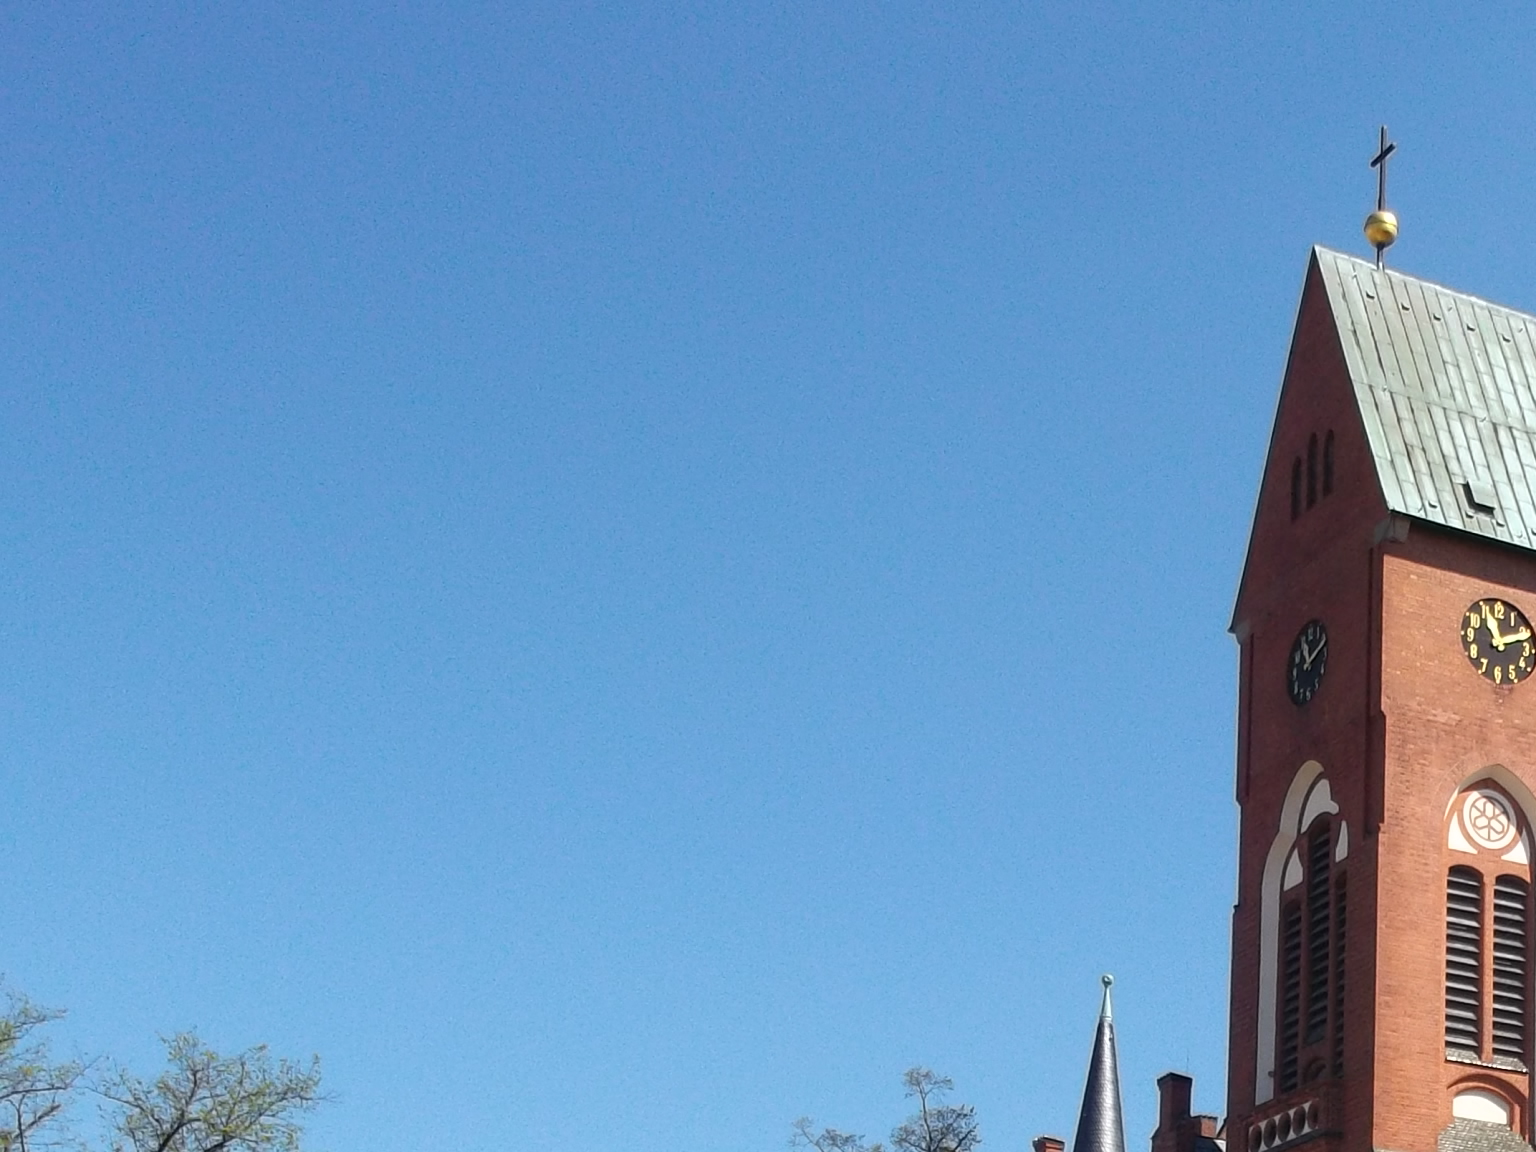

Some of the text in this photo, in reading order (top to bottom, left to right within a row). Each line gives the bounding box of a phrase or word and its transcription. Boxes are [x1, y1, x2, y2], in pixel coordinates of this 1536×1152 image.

[1494, 603, 1504, 619] 12
[1470, 612, 1480, 628] 10
[1510, 612, 1515, 627] 1
[1466, 627, 1474, 642] 9
[1470, 644, 1478, 659] 8
[1522, 642, 1530, 657] 3
[1480, 658, 1488, 673] 7
[1519, 656, 1526, 671] 4
[1494, 666, 1502, 681] 6
[1508, 665, 1516, 680] 5
